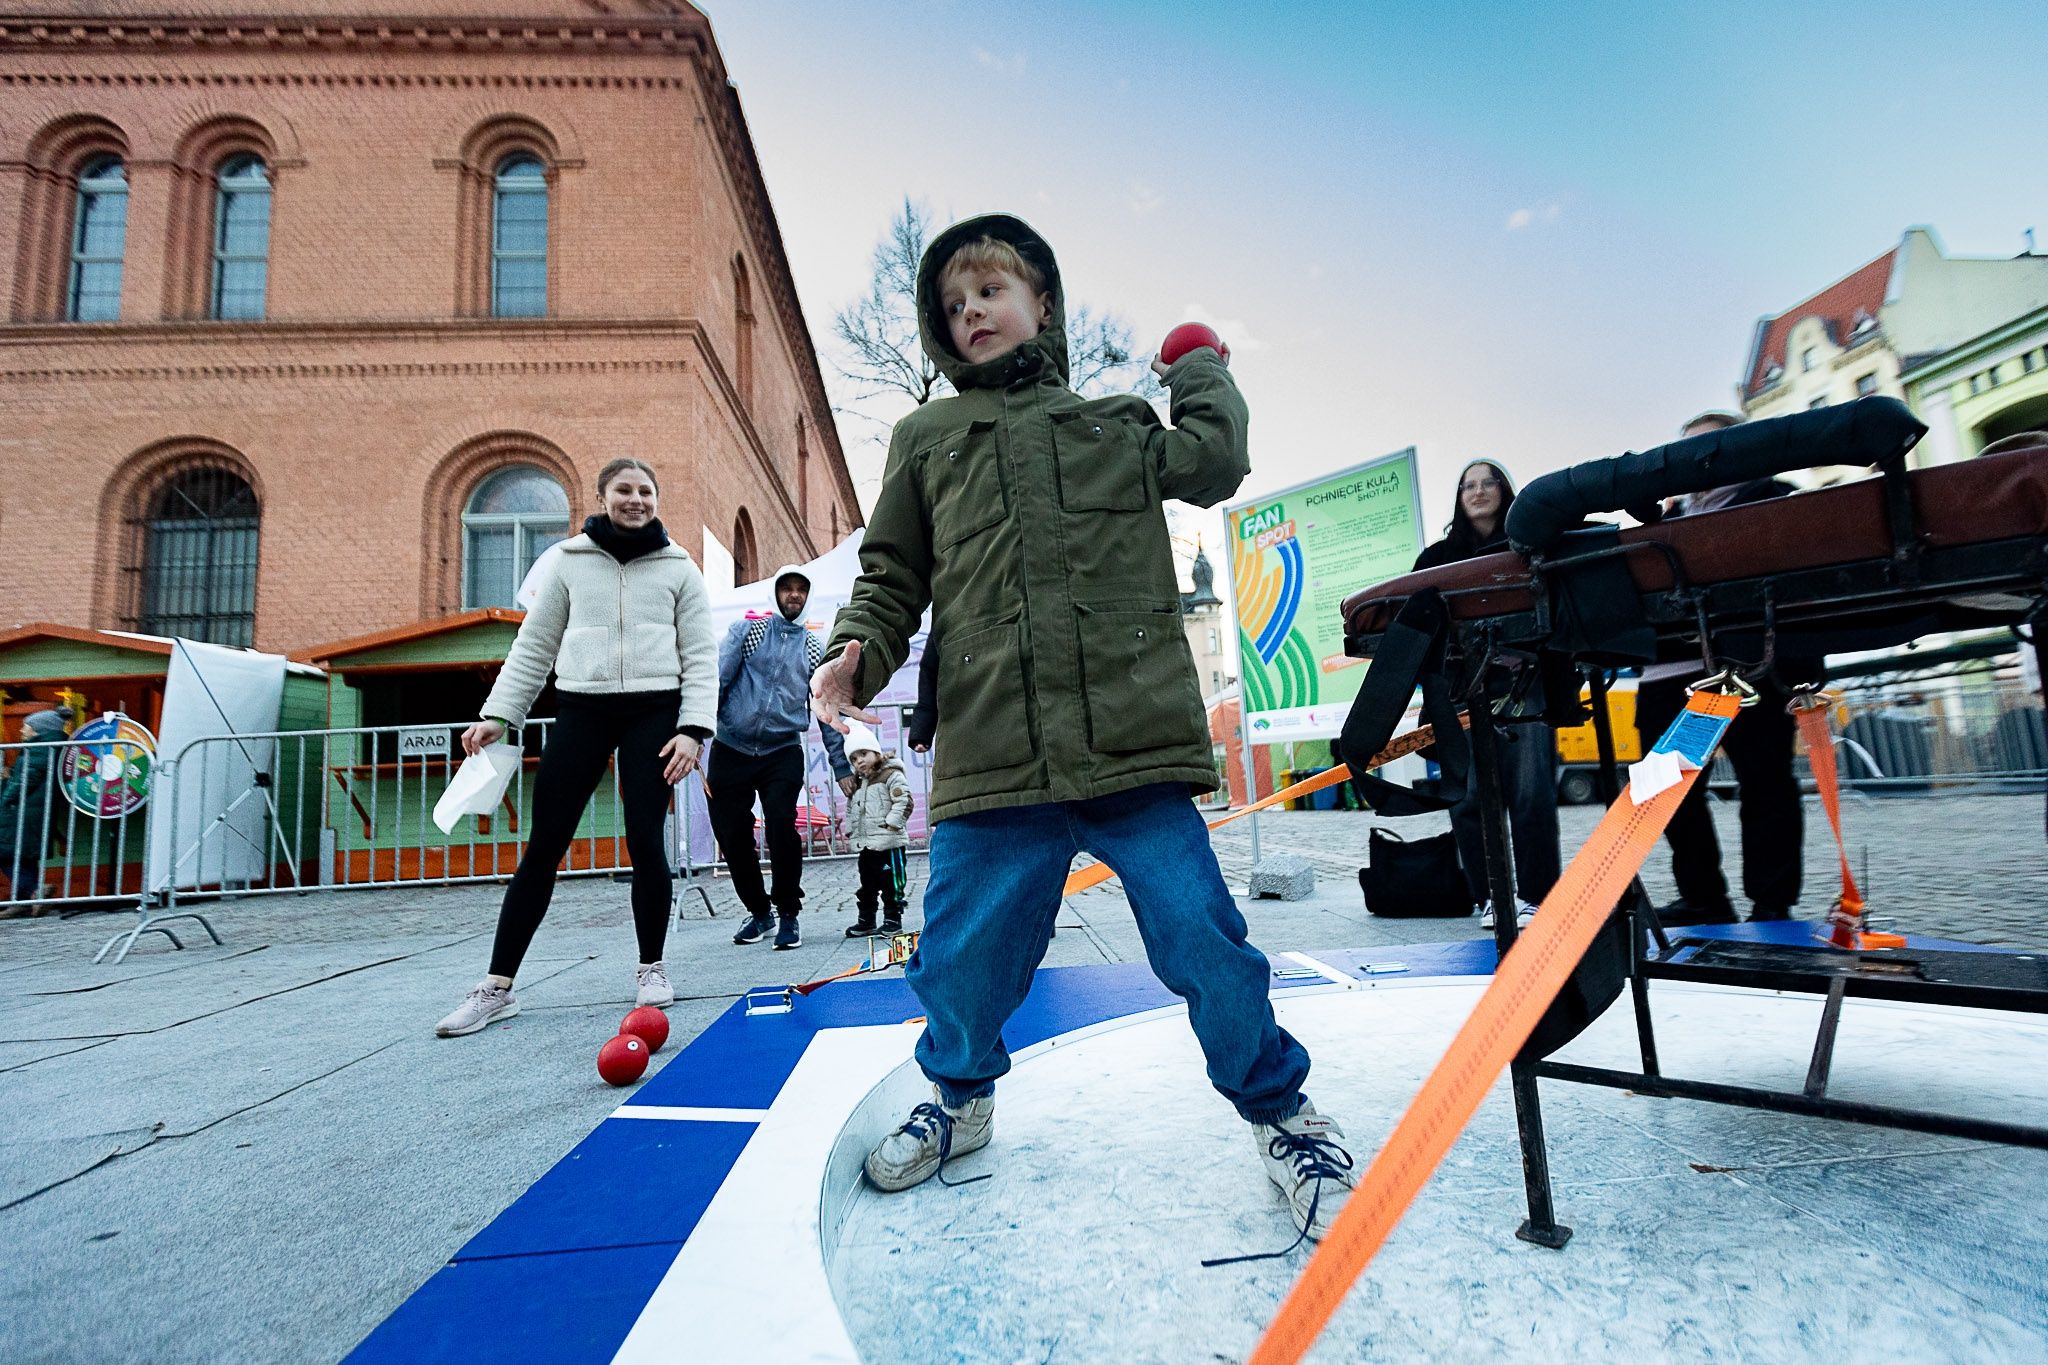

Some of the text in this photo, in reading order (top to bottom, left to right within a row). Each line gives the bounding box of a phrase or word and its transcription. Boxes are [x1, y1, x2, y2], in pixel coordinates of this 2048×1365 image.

[1366, 471, 1400, 489] KULĄ
[1357, 483, 1399, 502] SHOT PUT
[1243, 505, 1280, 539] FAN
[1256, 522, 1292, 547] SPOT
[404, 735, 446, 748] ARAD
